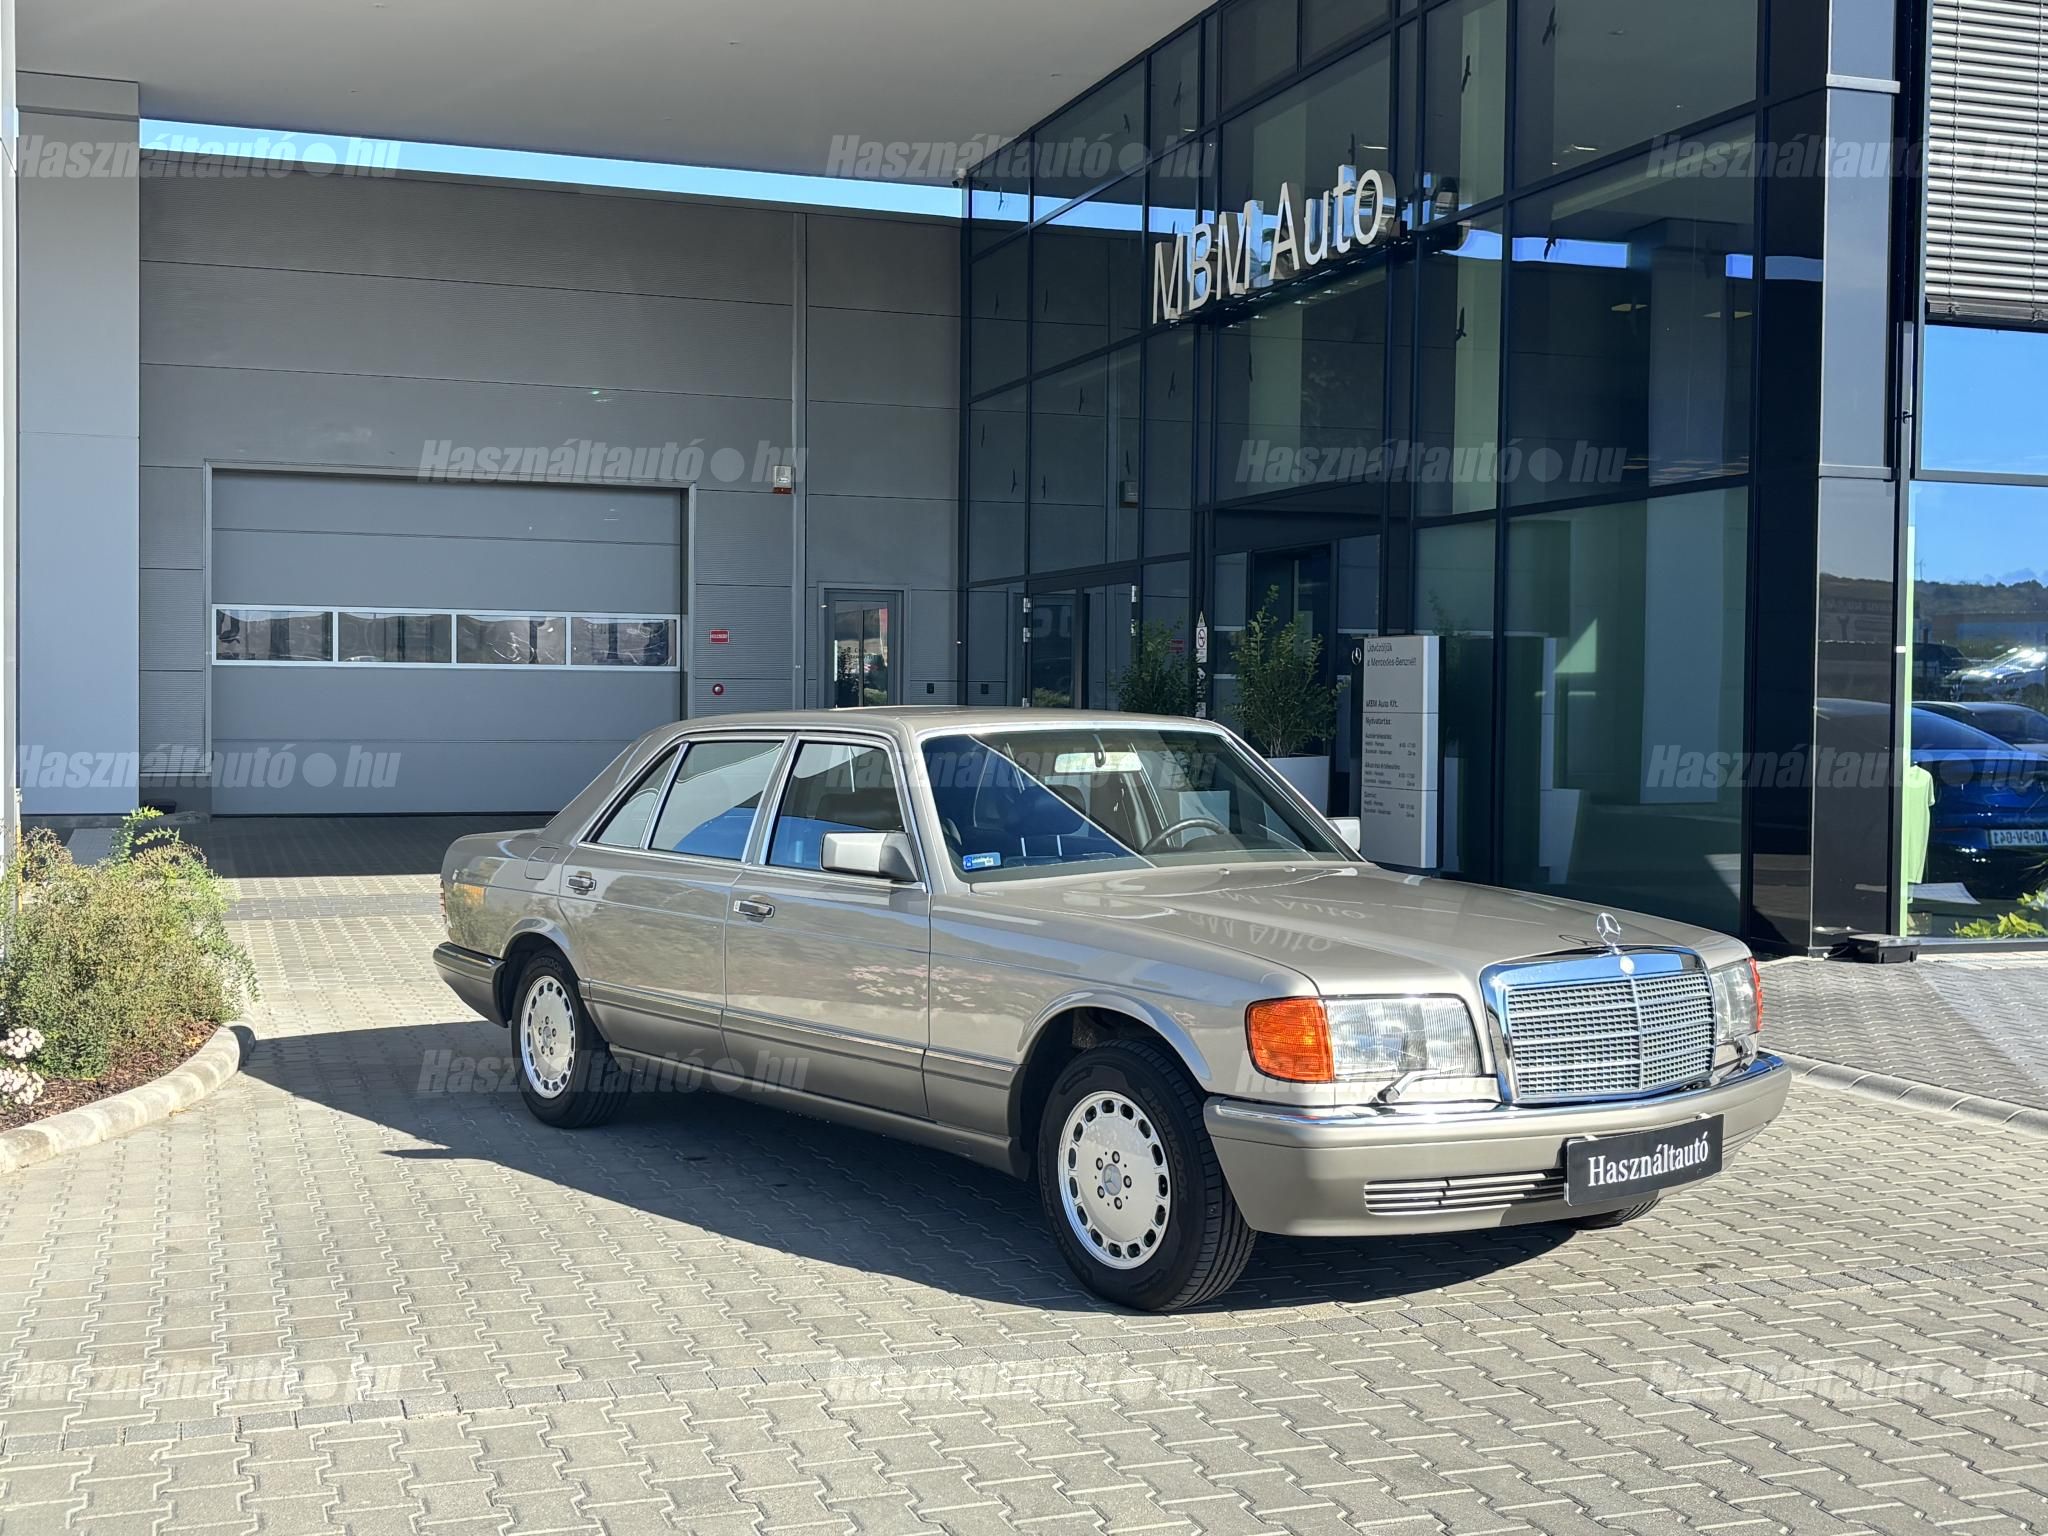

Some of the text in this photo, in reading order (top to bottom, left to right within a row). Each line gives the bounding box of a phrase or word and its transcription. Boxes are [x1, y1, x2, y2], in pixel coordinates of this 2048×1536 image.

[1153, 164, 1394, 325] MBM Auto
[1588, 1131, 1709, 1187] Használtautó
